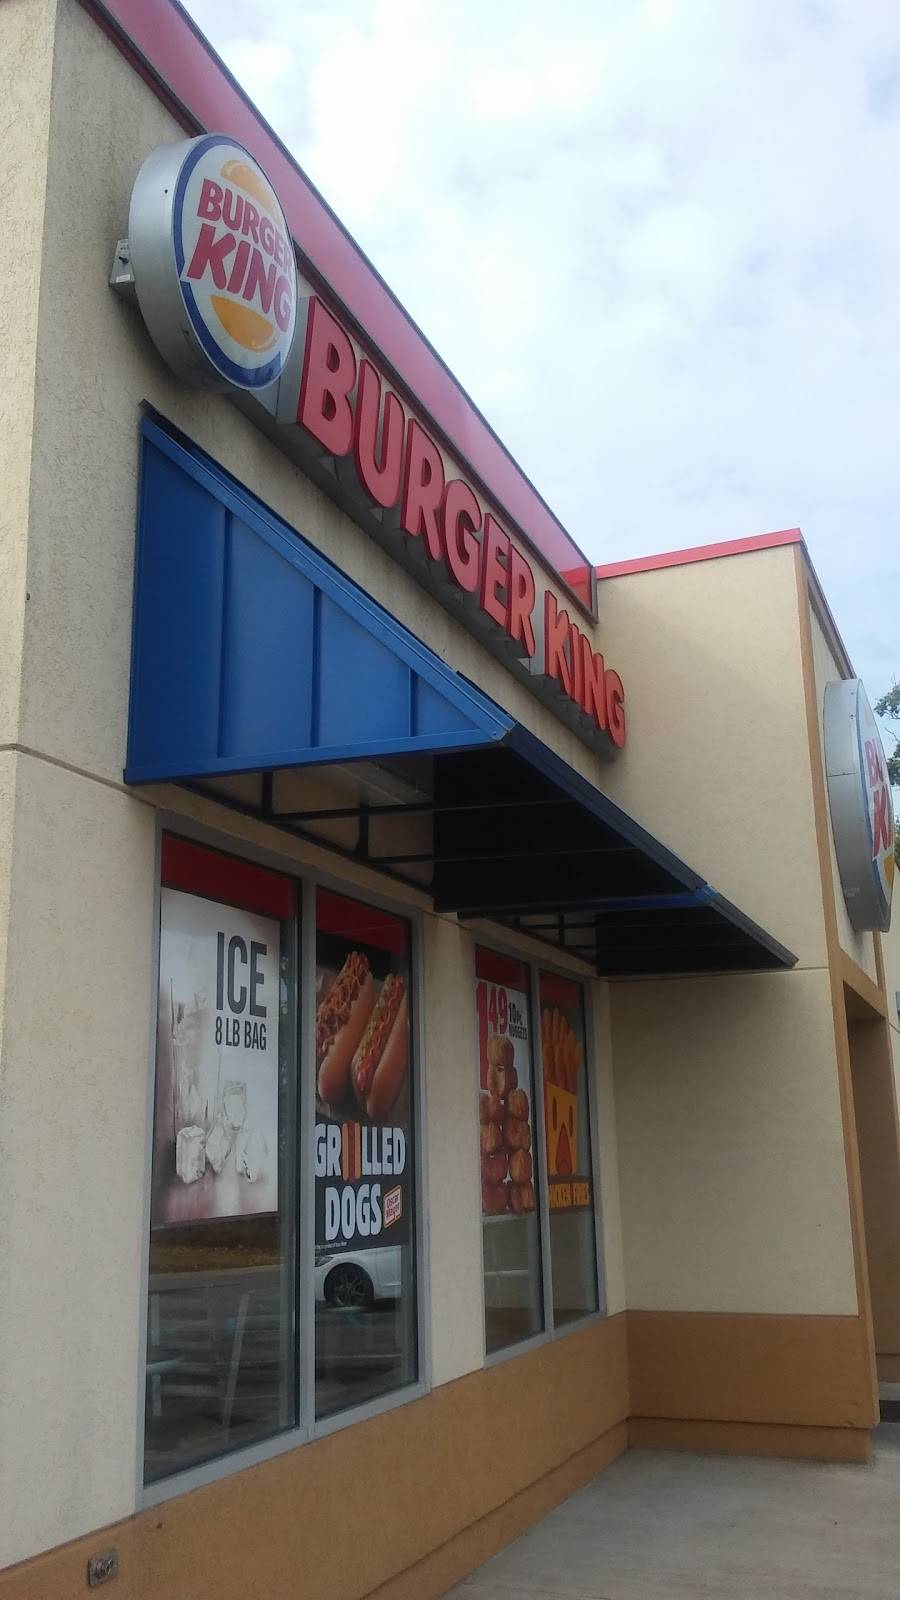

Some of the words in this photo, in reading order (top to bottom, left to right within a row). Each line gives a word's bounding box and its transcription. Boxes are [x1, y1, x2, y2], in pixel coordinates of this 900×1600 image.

[187, 223, 292, 332] KING
[297, 295, 536, 657] BURGER
[544, 590, 626, 748] KING
[216, 931, 267, 1018] ICE
[215, 1015, 223, 1045] 8
[225, 1017, 240, 1047] LB
[244, 1020, 266, 1051] BAG
[315, 1119, 406, 1182] GRILLED
[325, 1183, 382, 1241] DOGS
